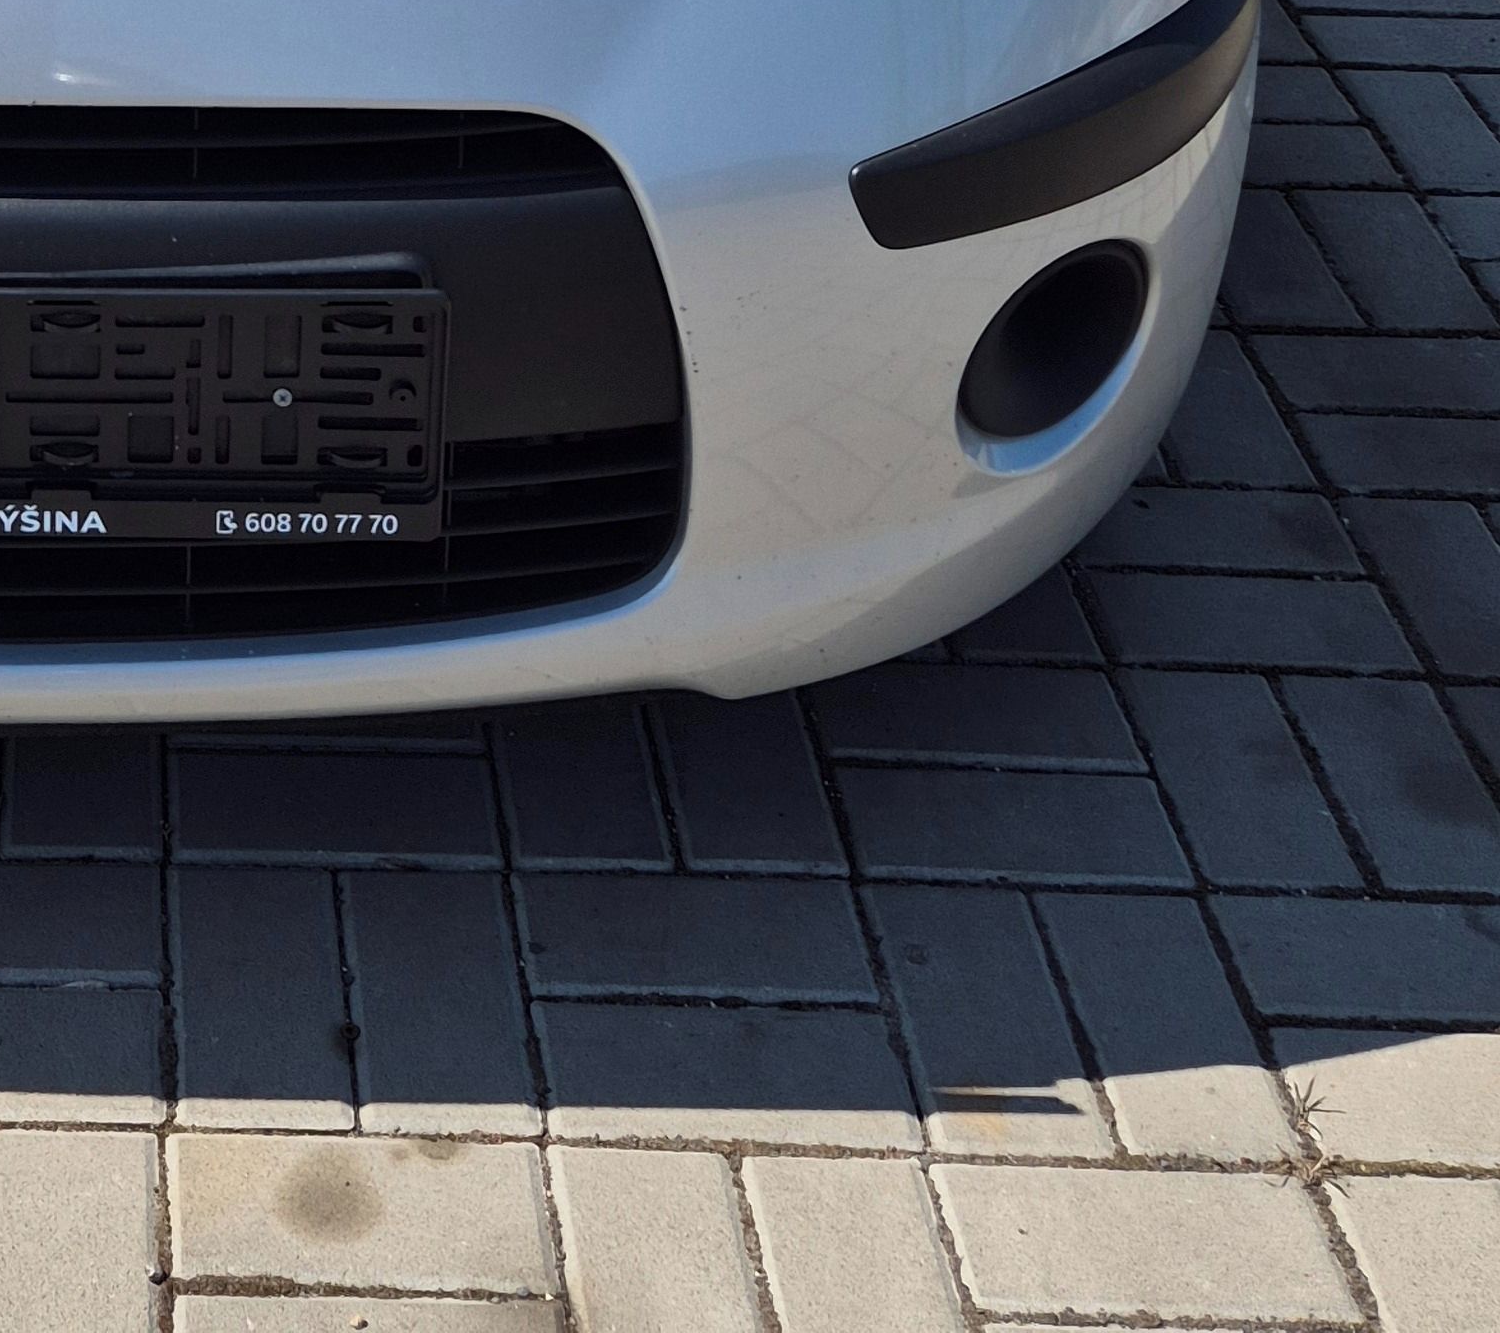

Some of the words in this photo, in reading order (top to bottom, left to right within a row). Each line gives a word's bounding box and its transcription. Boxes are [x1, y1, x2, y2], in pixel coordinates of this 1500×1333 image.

[244, 512, 292, 533] 608
[298, 513, 329, 534] 70
[334, 514, 363, 534] 77
[368, 514, 399, 535] 70
